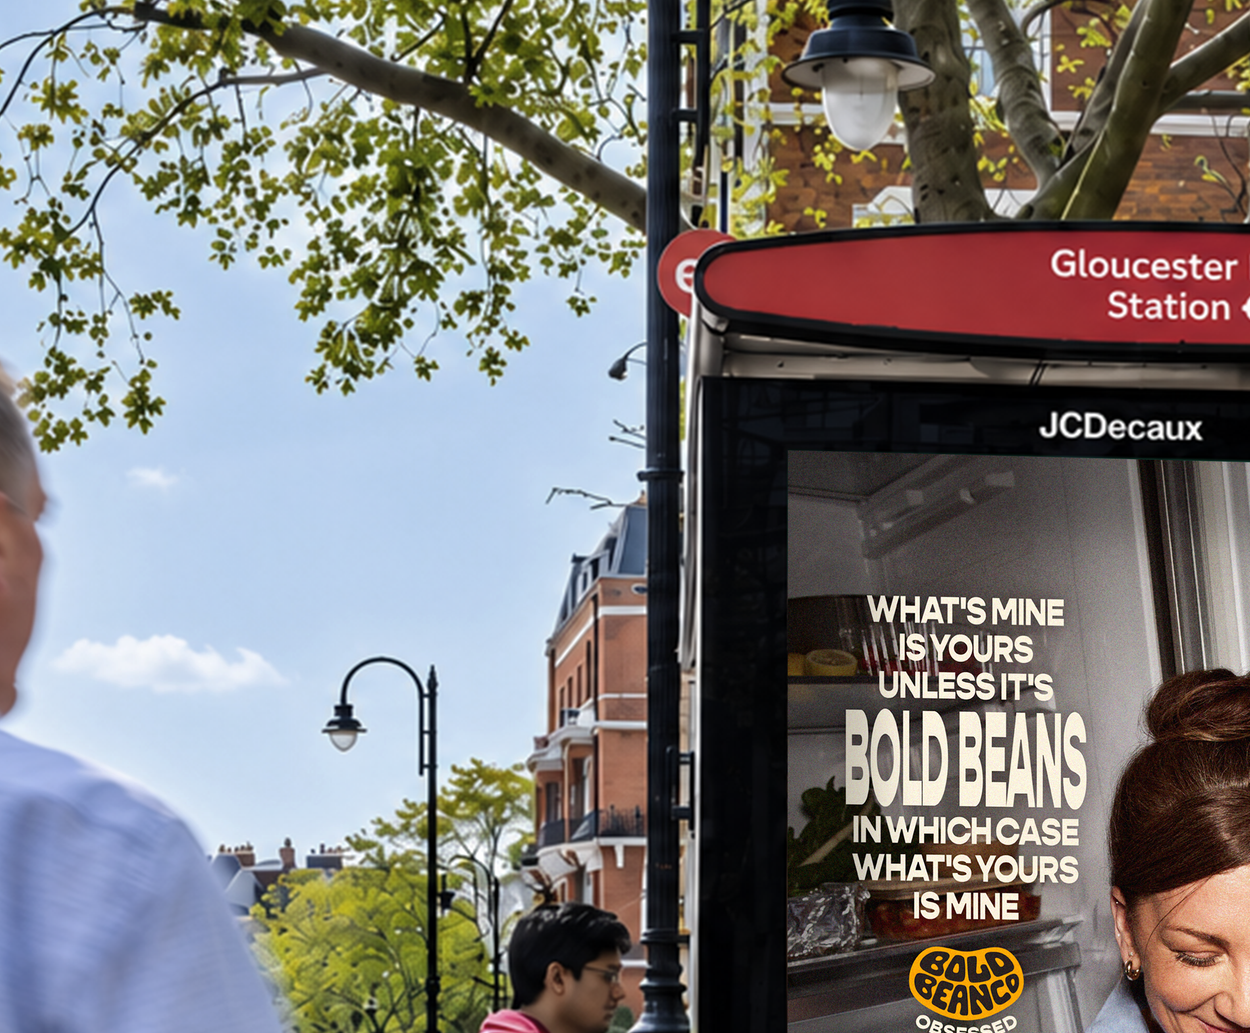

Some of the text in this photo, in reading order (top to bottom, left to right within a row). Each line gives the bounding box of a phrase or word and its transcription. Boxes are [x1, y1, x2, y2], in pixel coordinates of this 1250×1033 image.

[1051, 248, 1239, 281] Gloucester
[1108, 290, 1230, 321] Station
[1039, 411, 1203, 441] JCDecaux
[866, 595, 1065, 627] WHAT'S MINE
[899, 633, 1034, 664] IS YOURS
[878, 670, 1054, 702] UNLESS IT'S
[845, 708, 1088, 811] BOLD BEANS
[853, 815, 1080, 847] IN WHICH CASE
[852, 853, 1080, 884] WHAT'S YOURS
[913, 891, 1019, 921] IS MINE
[920, 951, 1015, 983] BOLD
